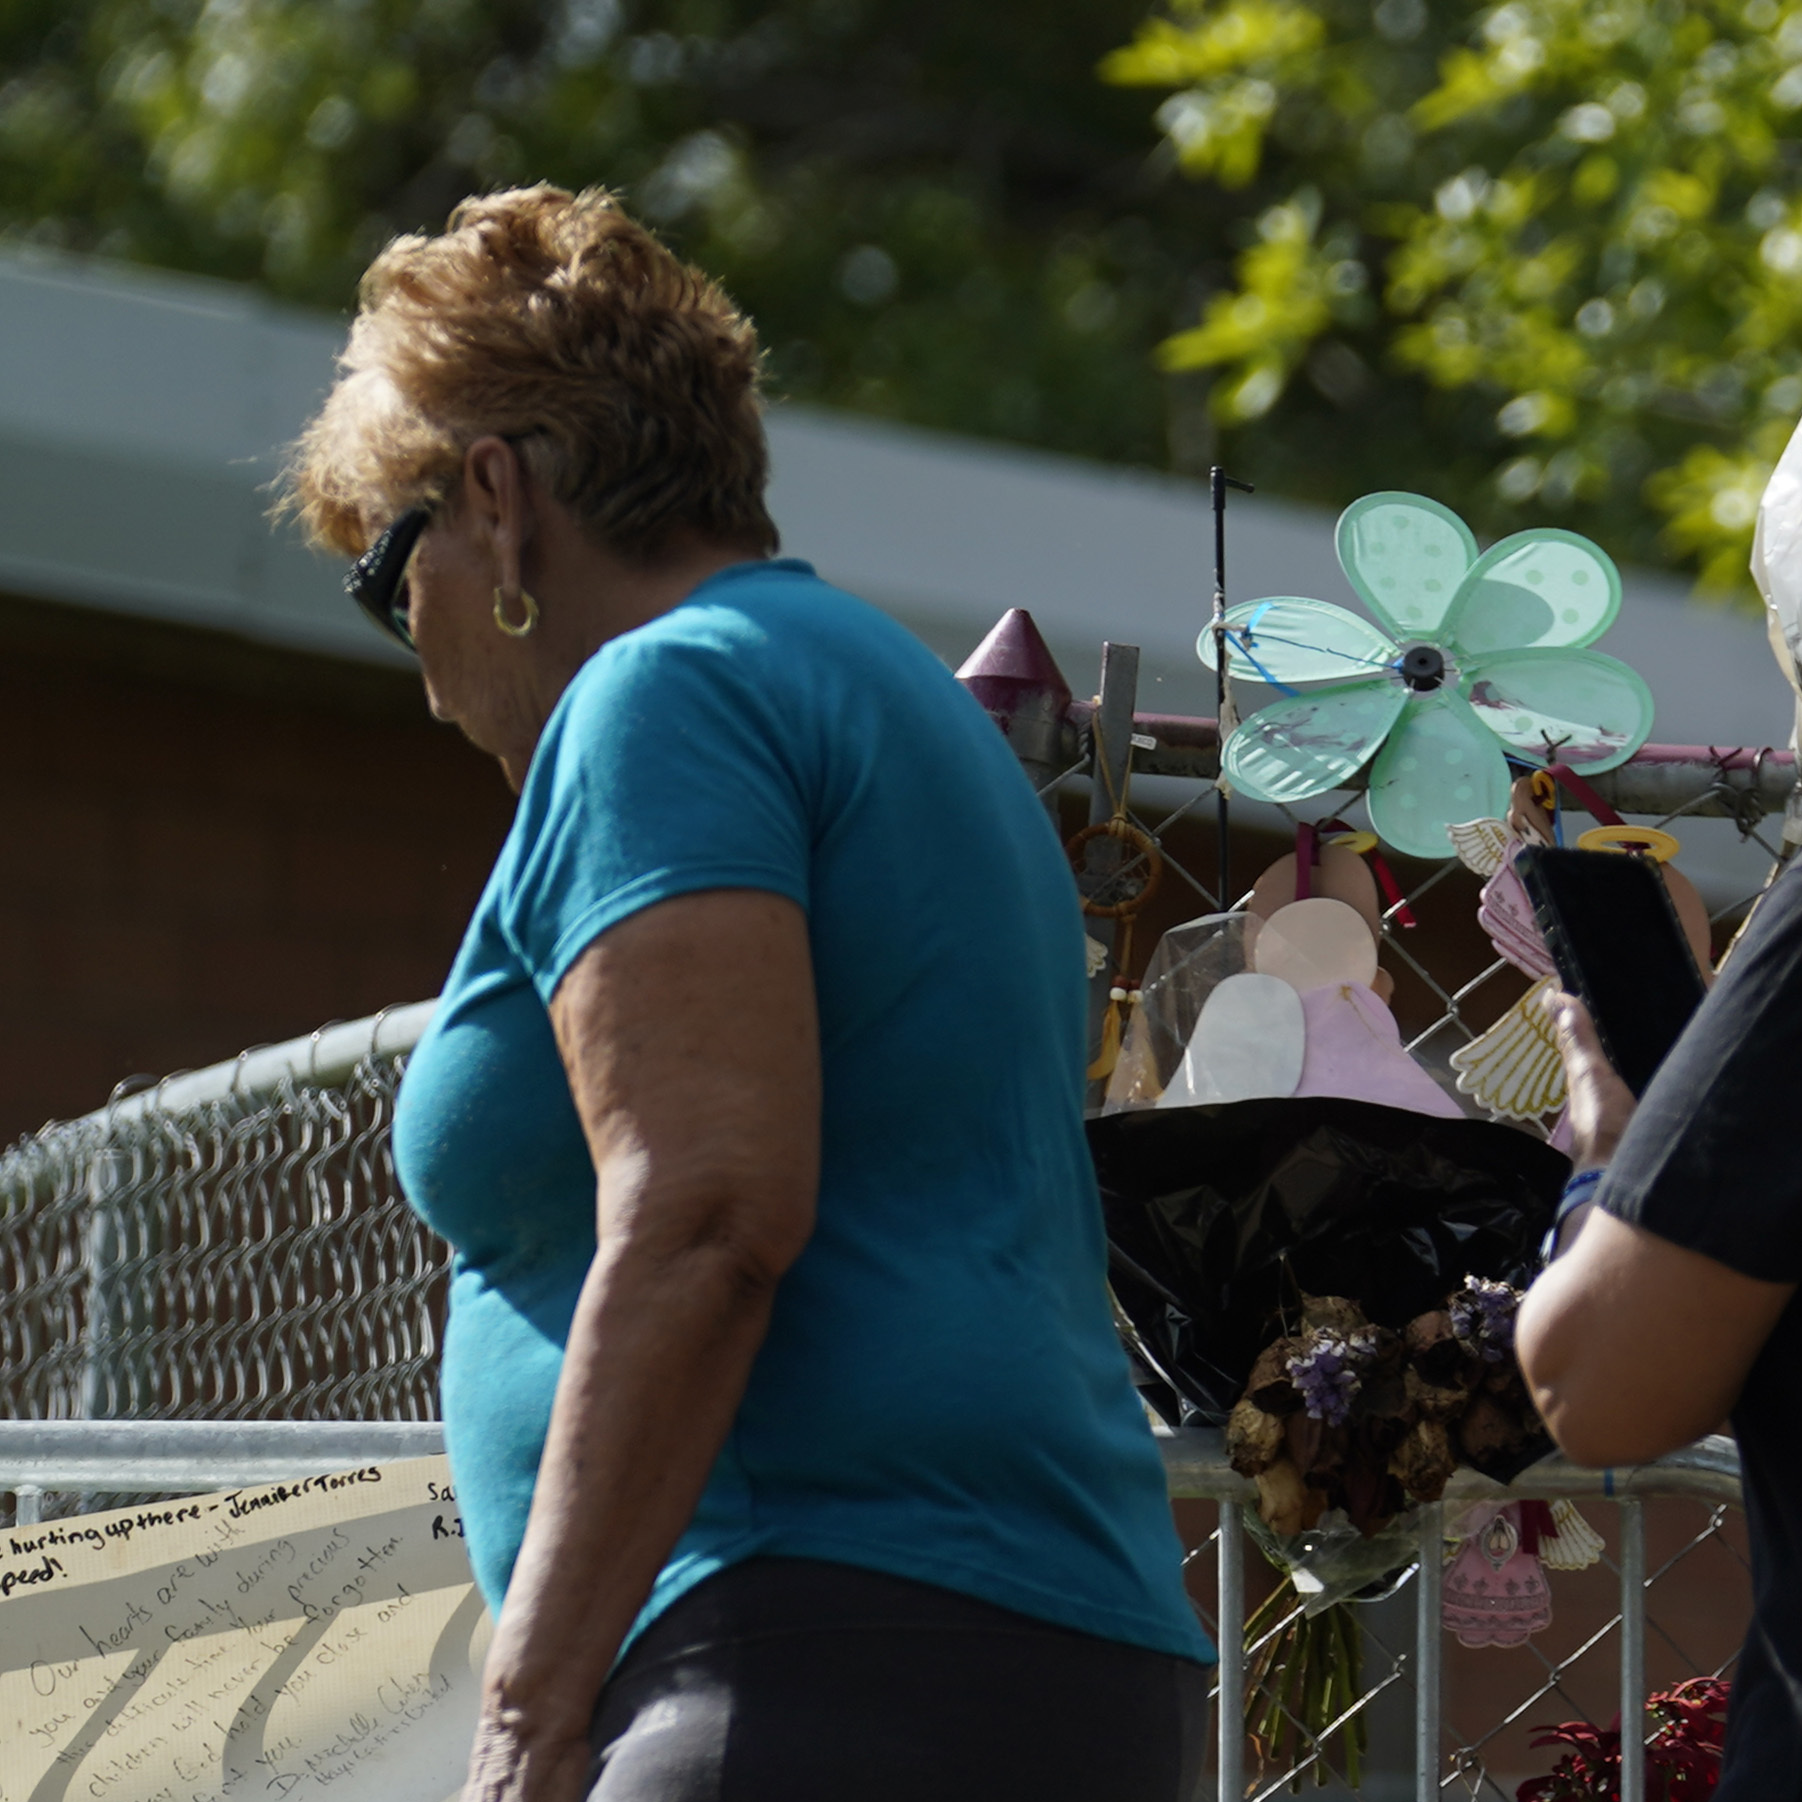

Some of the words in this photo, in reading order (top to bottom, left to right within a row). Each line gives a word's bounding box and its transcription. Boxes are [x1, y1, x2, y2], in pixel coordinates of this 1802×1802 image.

[10, 1525, 105, 1557] hurting
[105, 1518, 134, 1544] up
[132, 1504, 202, 1531] there
[314, 1465, 382, 1493] Torres
[287, 1526, 351, 1602] precious
[29, 1713, 75, 1749] you
[165, 1597, 235, 1645] family
[237, 1538, 297, 1596] during
[30, 1657, 80, 1697] Our
[79, 1601, 152, 1659] hearts
[157, 1565, 196, 1605] are
[199, 1519, 246, 1568] with
[214, 1694, 267, 1742] hold
[275, 1670, 314, 1711] you
[377, 1582, 412, 1624] and
[211, 1661, 260, 1701] never
